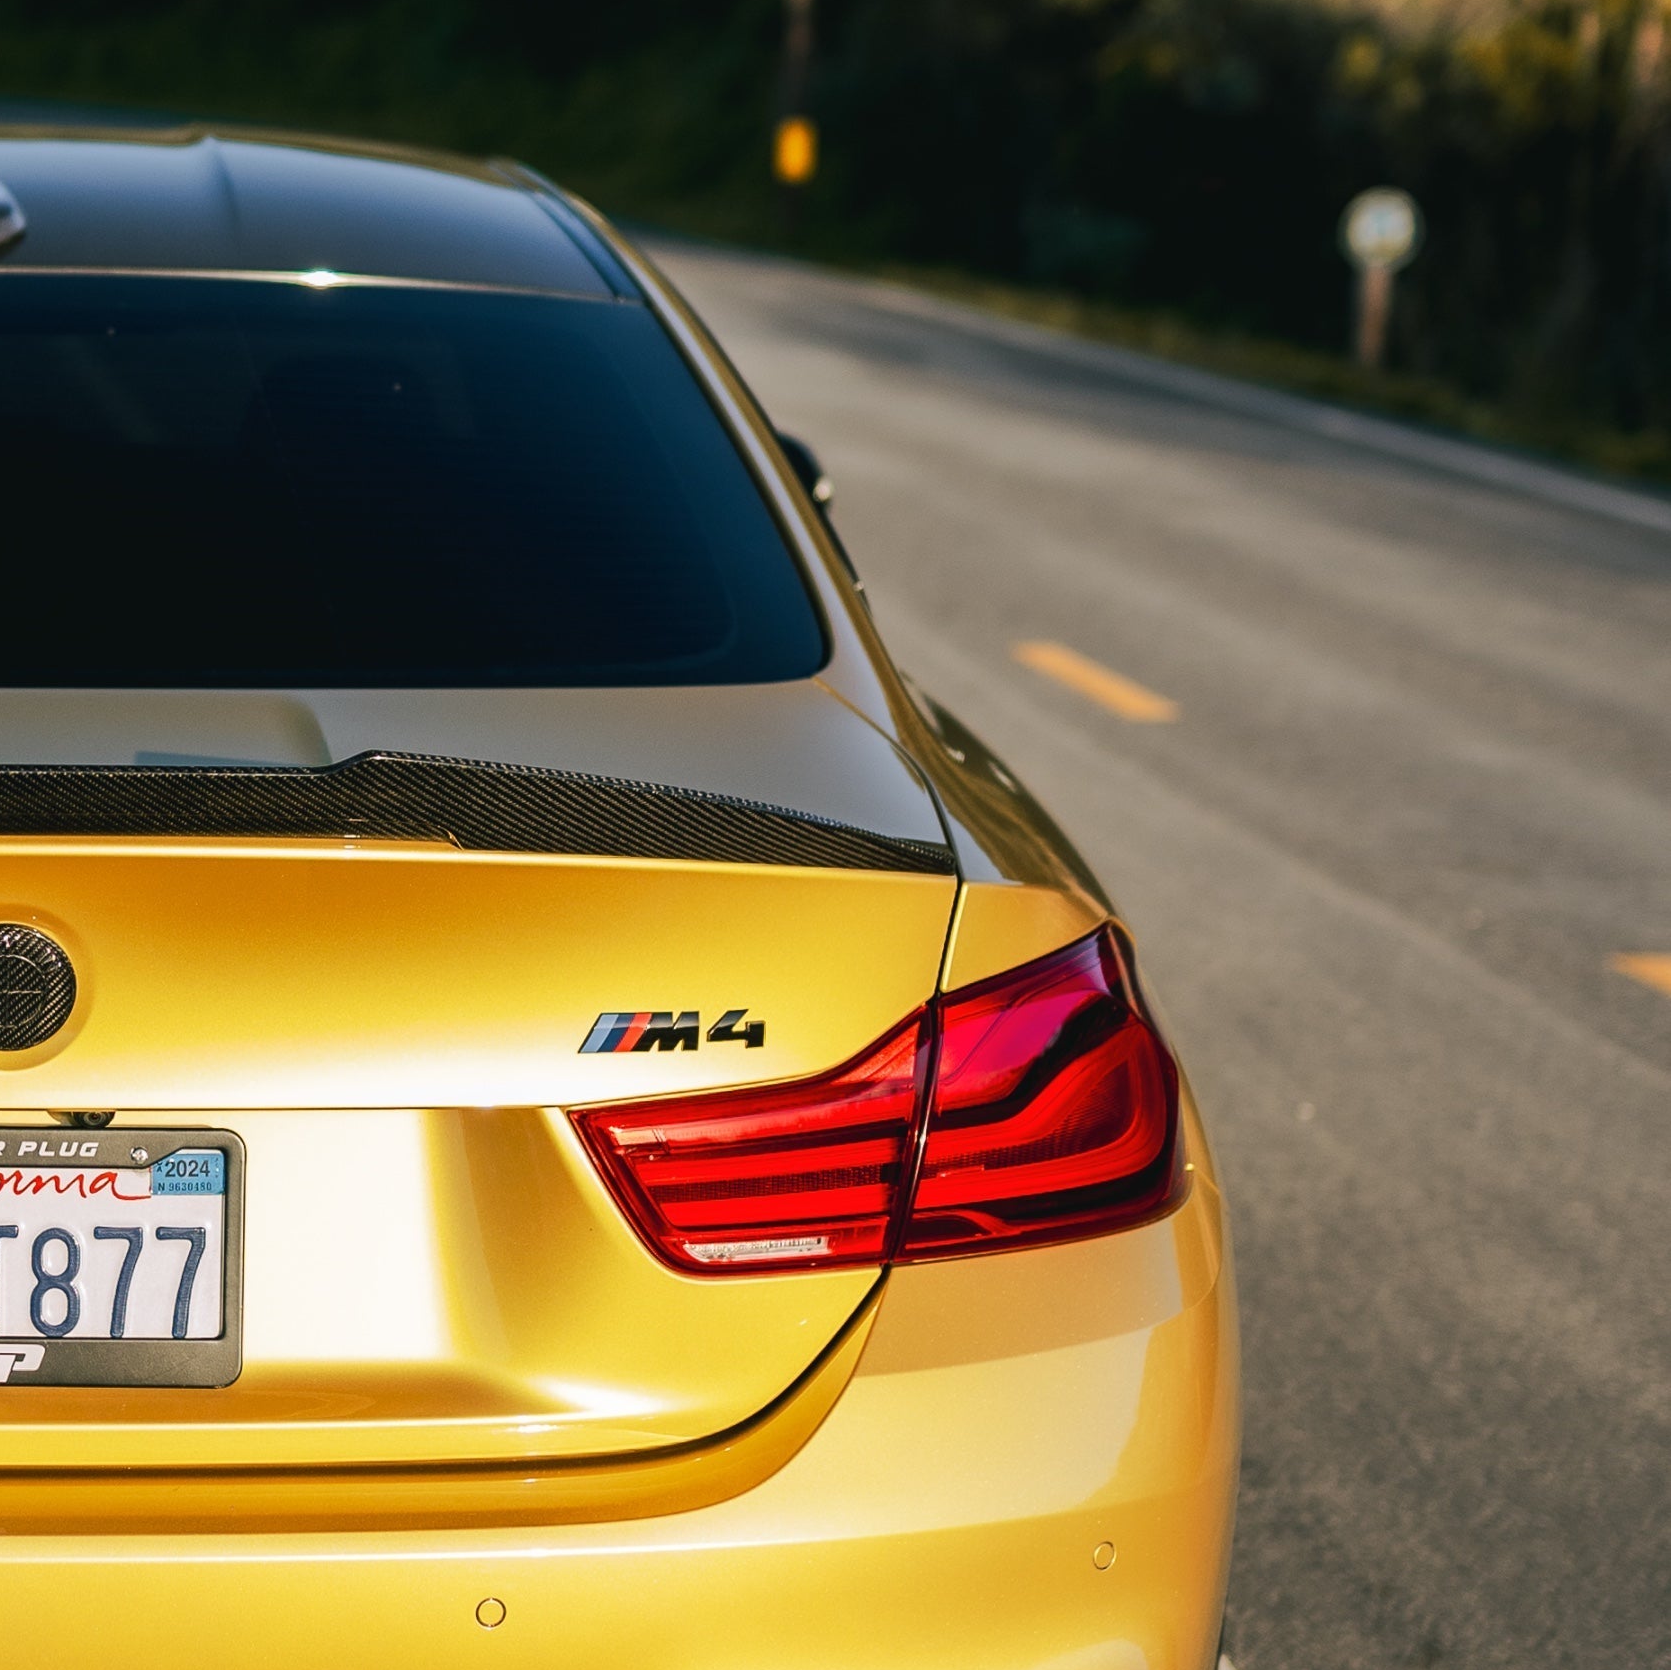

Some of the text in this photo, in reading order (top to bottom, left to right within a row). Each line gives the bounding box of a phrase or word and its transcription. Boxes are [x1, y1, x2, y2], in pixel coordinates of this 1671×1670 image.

[630, 1009, 765, 1053] M4
[17, 1140, 100, 1158] PLUG
[165, 1159, 210, 1178] 2024
